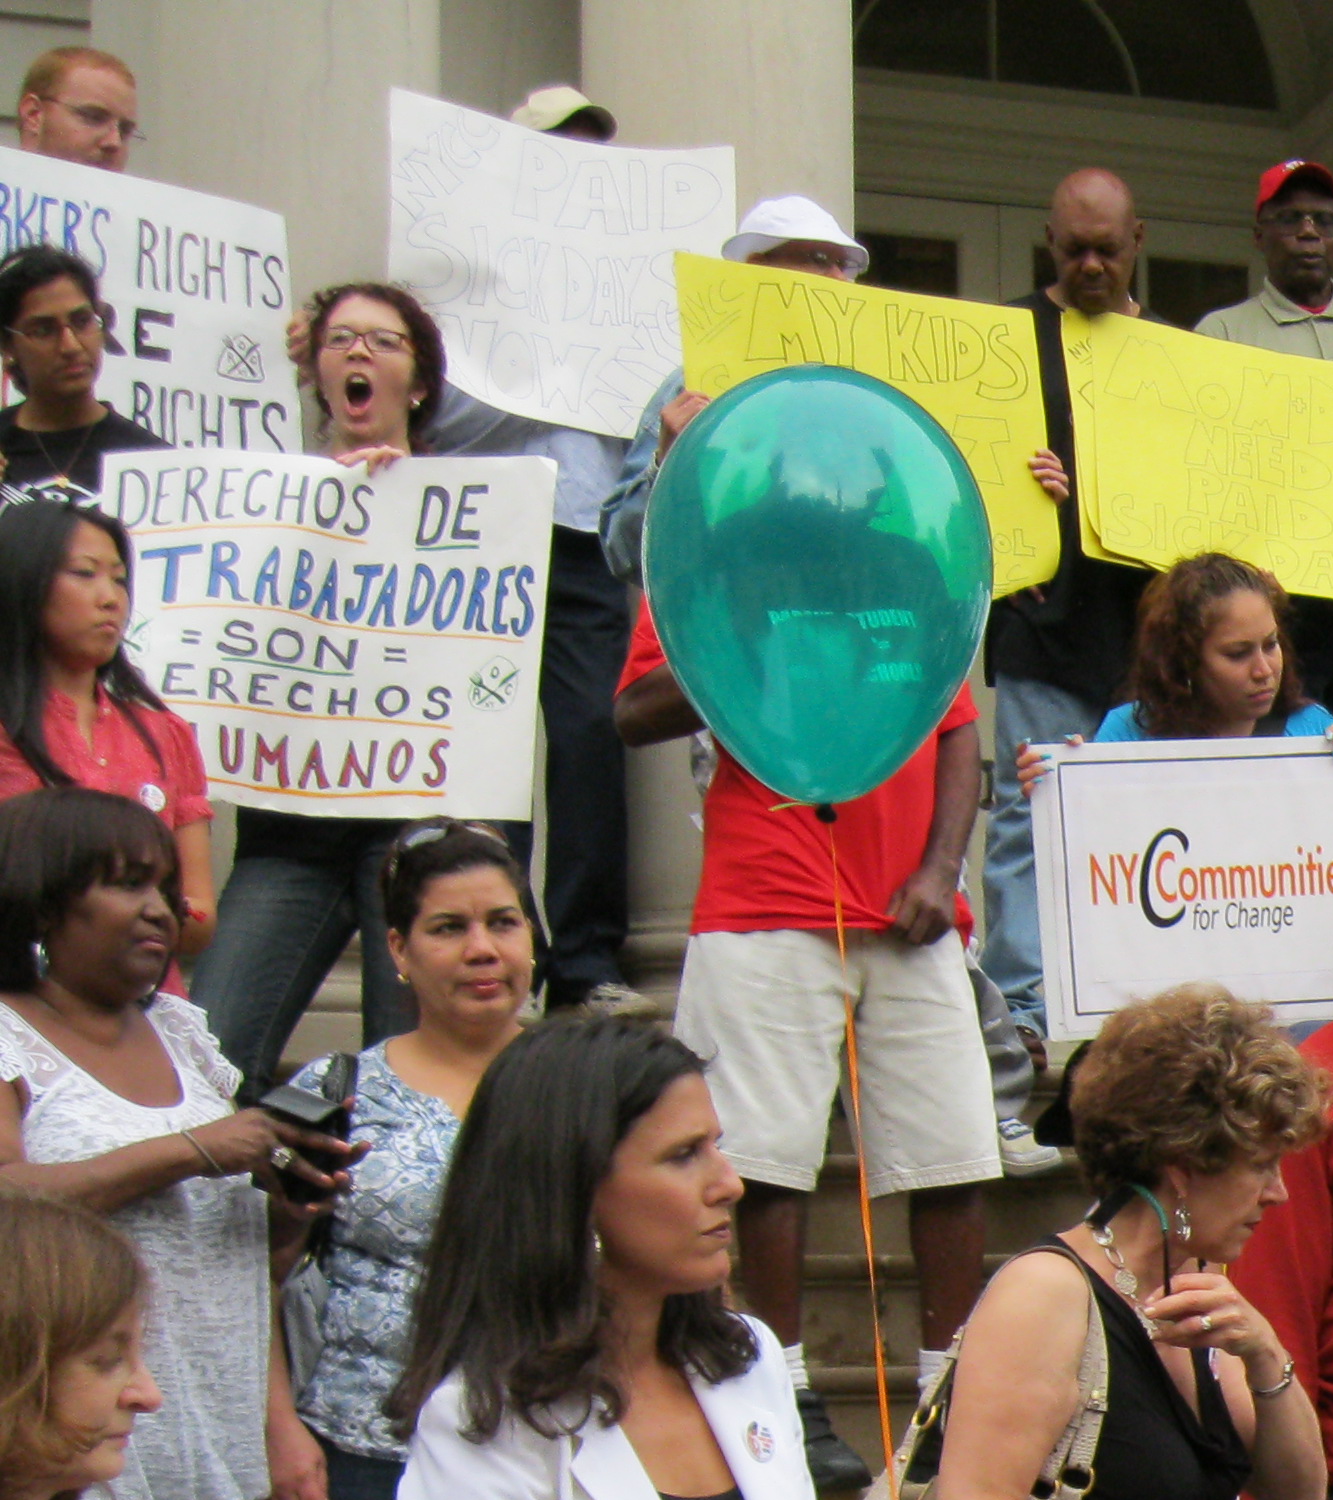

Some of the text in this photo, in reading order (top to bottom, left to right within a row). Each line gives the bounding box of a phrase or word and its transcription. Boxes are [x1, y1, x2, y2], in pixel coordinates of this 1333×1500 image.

[513, 139, 722, 236] PAID
[137, 217, 285, 309] RIGHTS
[406, 213, 550, 324] SICK
[437, 313, 600, 414] NOW
[745, 282, 1028, 400] MY KIDS
[1185, 419, 1332, 490] NEED
[117, 466, 488, 546] DERECHOS DE
[1105, 493, 1249, 551] SICK
[1187, 468, 1333, 540] PAID
[141, 541, 535, 637] TRABAJADORES
[217, 620, 358, 669] SON
[161, 663, 453, 720] ERECHOS
[219, 725, 450, 789] UMANOS
[1193, 901, 1295, 934] for Change
